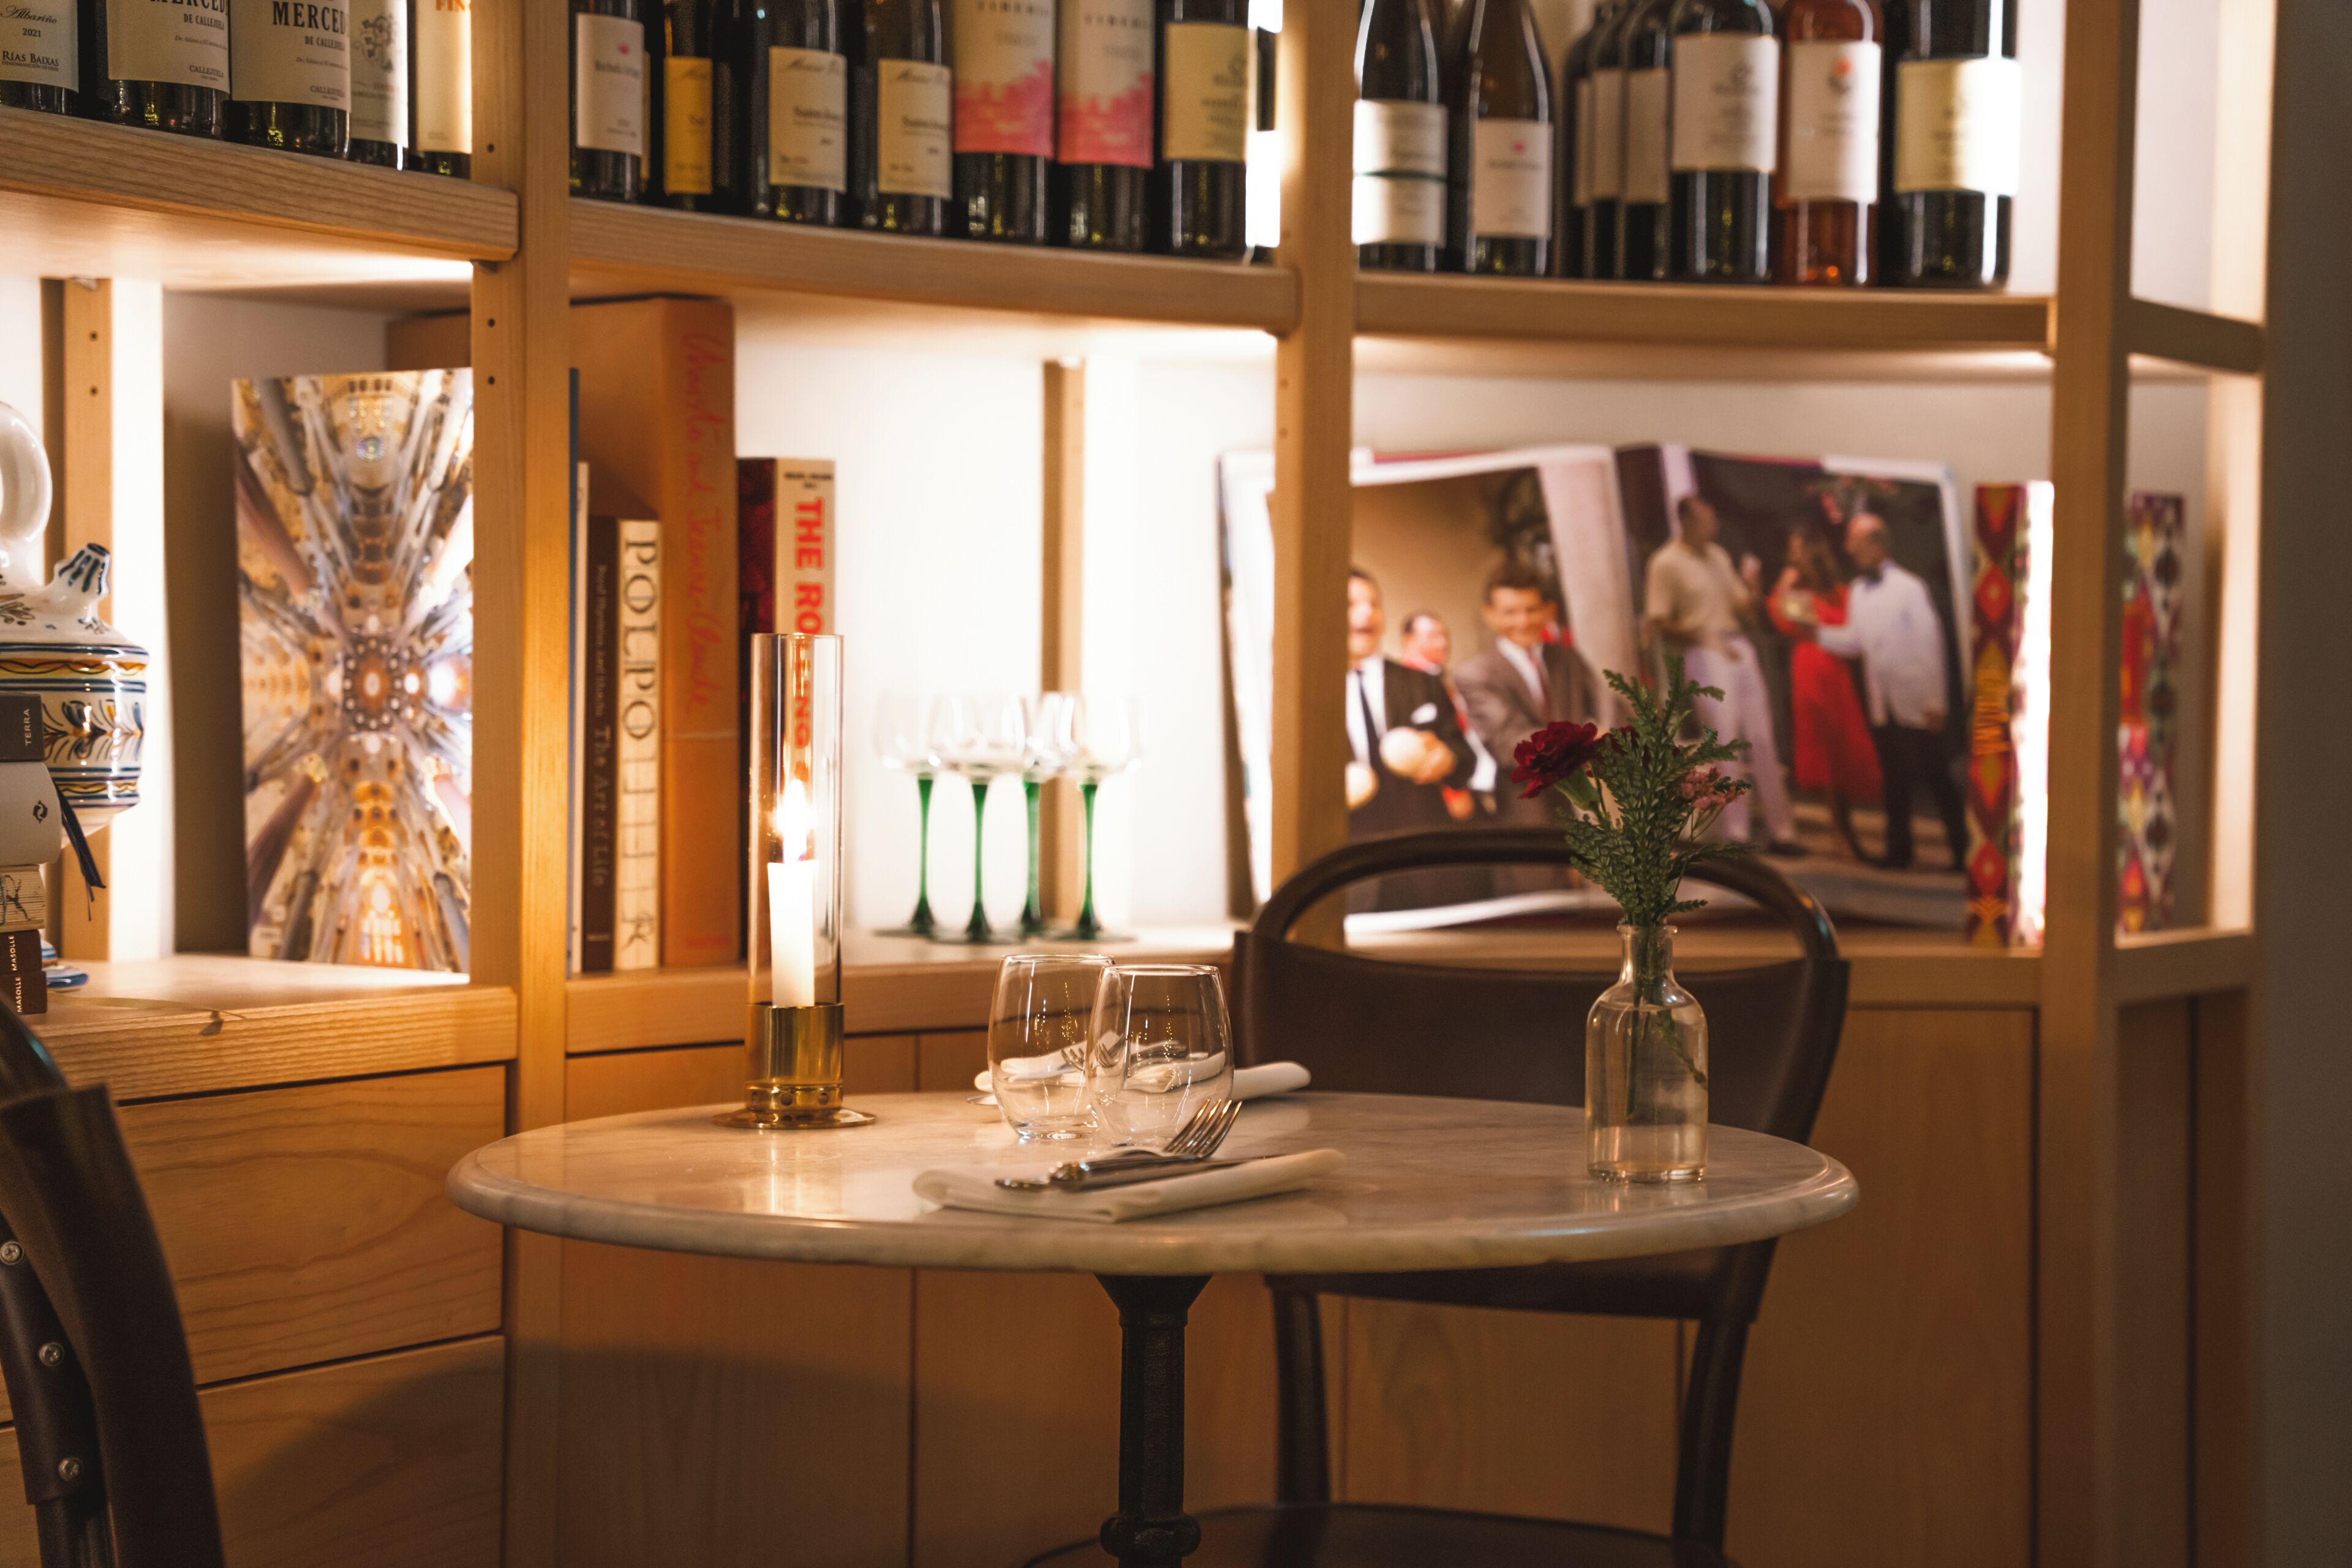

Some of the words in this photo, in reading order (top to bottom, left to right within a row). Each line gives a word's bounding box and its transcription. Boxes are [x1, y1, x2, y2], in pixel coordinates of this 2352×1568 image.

[0, 5, 58, 24] Albariño
[183, 13, 193, 23] DE
[22, 28, 42, 37] 2021
[304, 36, 314, 46] DE
[30, 53, 59, 67] BAIXAS
[796, 496, 824, 570] THE
[623, 540, 657, 740] POLPO
[23, 708, 32, 747] TERRA
[594, 725, 611, 766] The
[9, 935, 17, 971] MASOLLE
